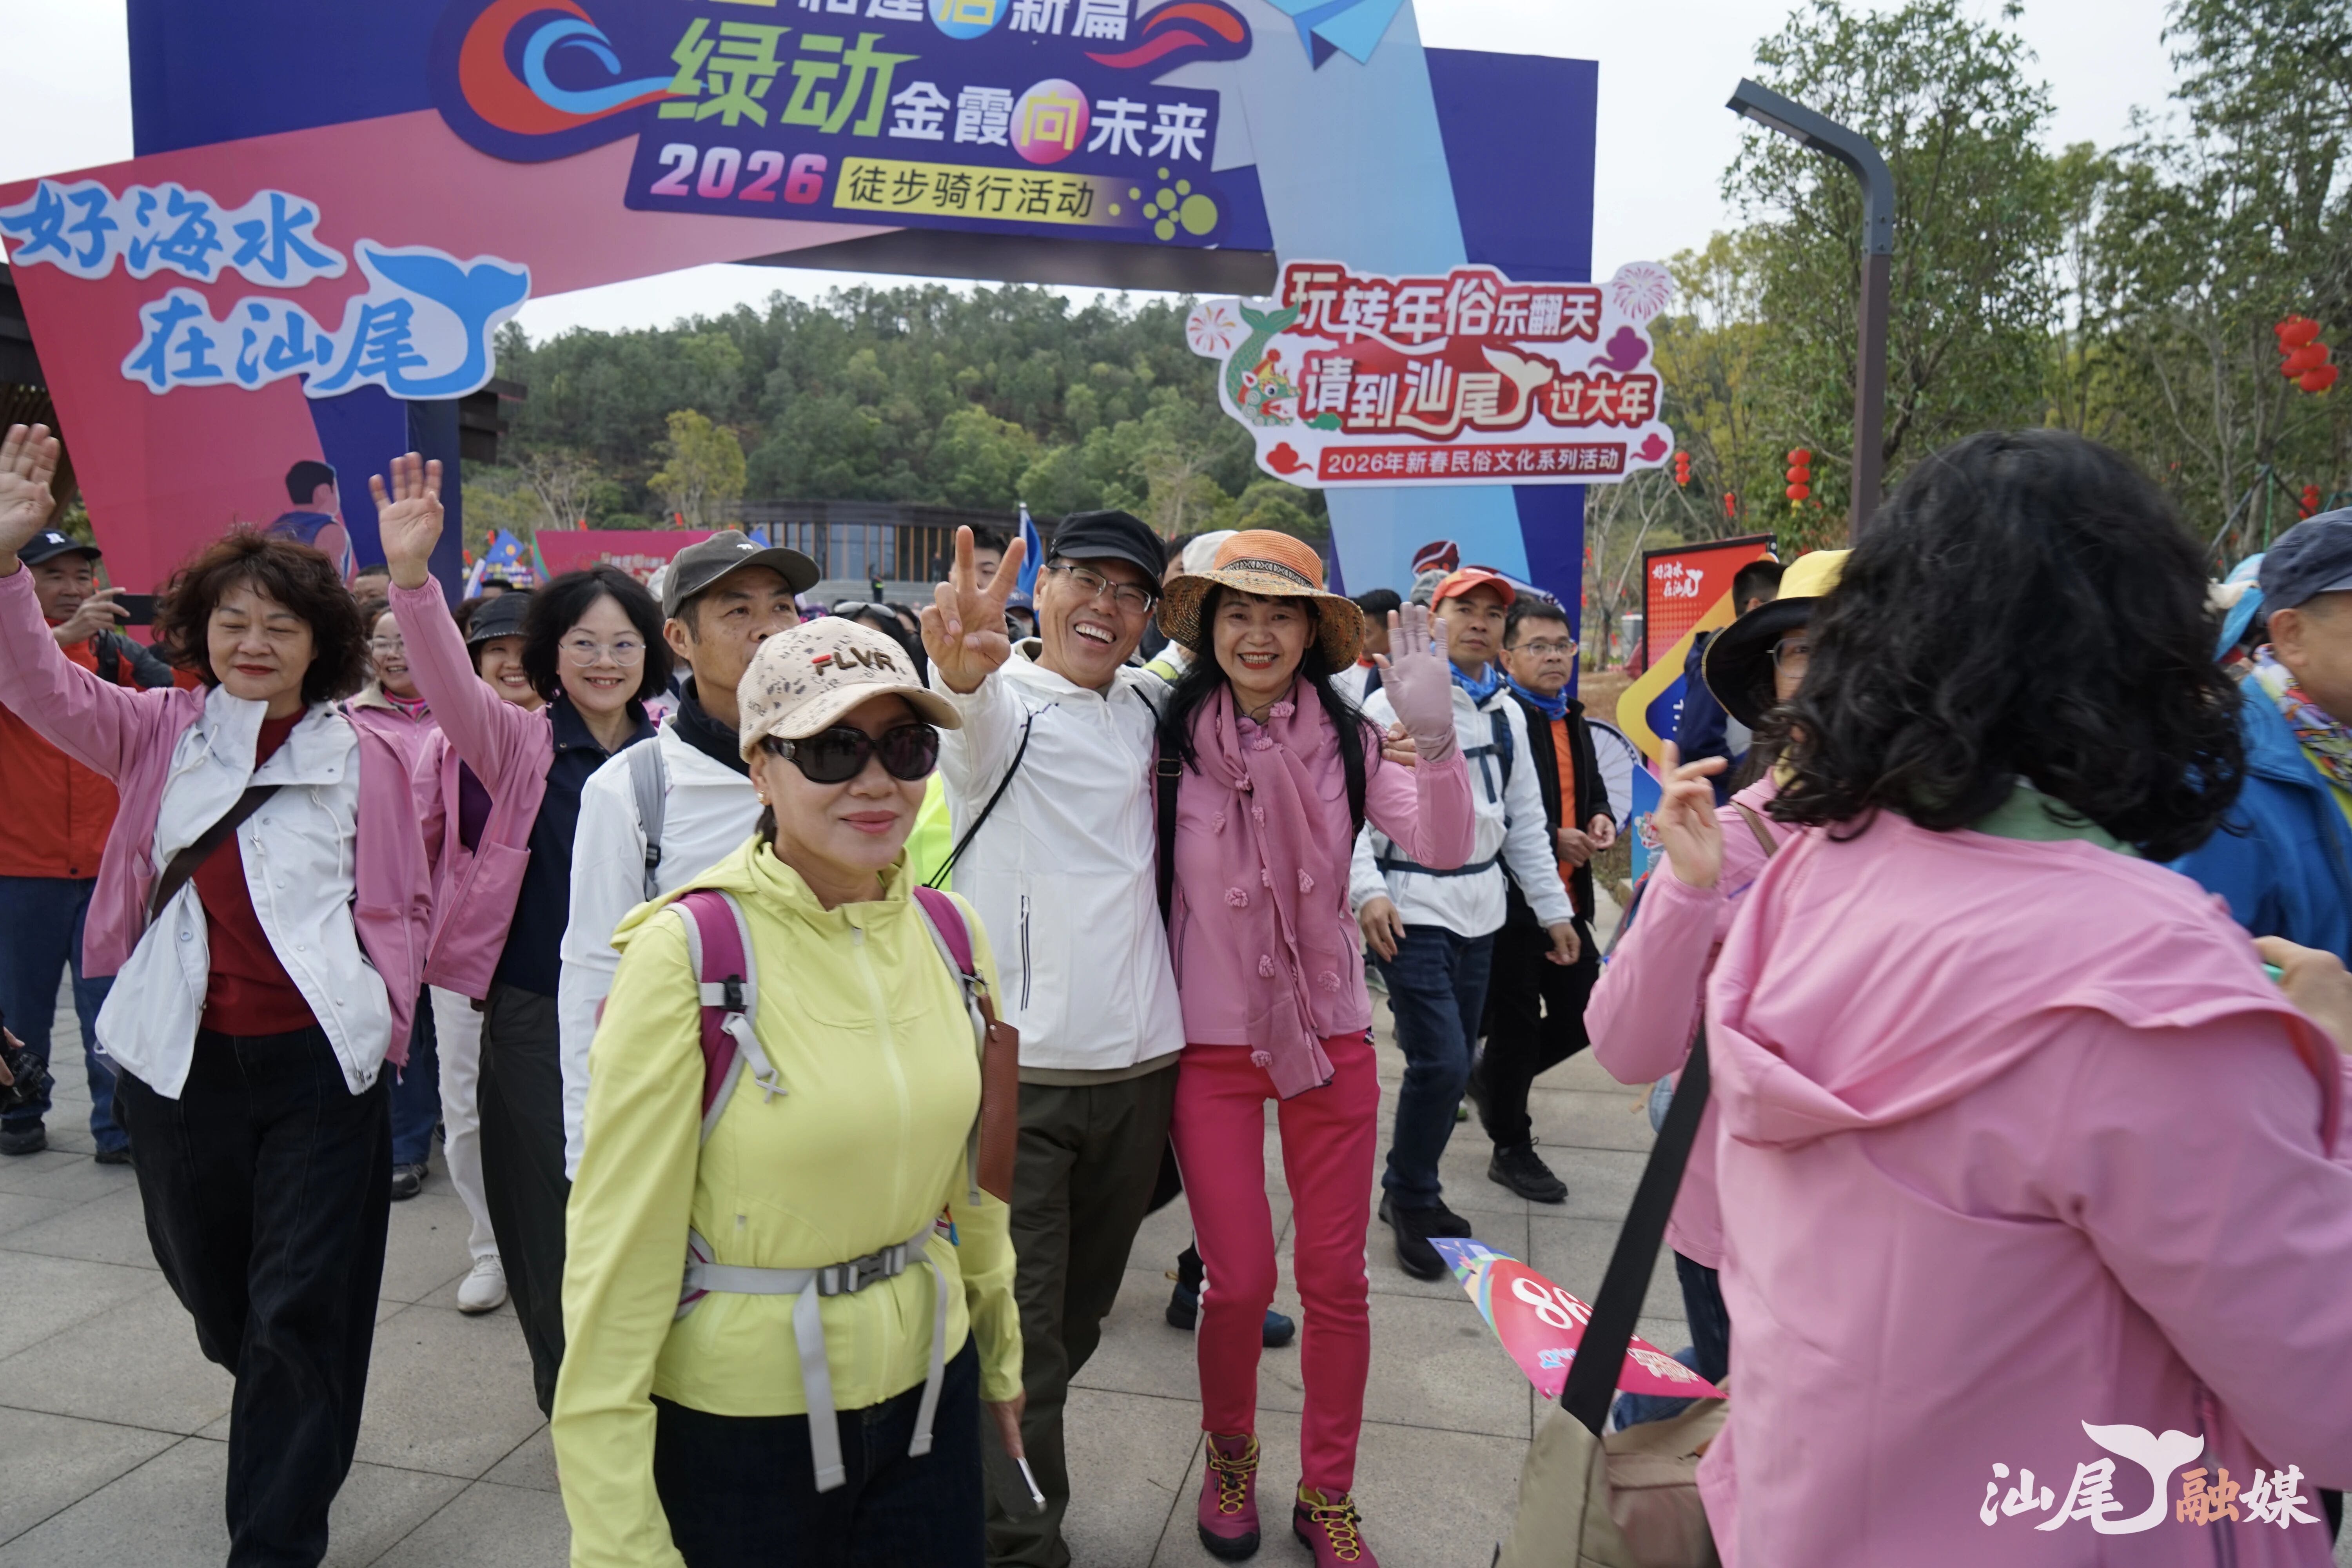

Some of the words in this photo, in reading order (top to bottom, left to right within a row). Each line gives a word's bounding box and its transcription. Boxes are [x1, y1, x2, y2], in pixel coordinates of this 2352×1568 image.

[658, 18, 1208, 161] 绿动金霞向未来
[650, 143, 828, 204] 2026
[849, 165, 1094, 218] 徒步骑行活动
[1, 180, 340, 279] 好海水
[129, 247, 528, 397] 在汕尾
[1289, 271, 1596, 356] 玩转年俗乐翻天
[1305, 344, 1651, 435] 请到汕尾过大年
[1327, 448, 1619, 474] 2026年新春民俗文化系列活动
[812, 647, 897, 676] FLVR
